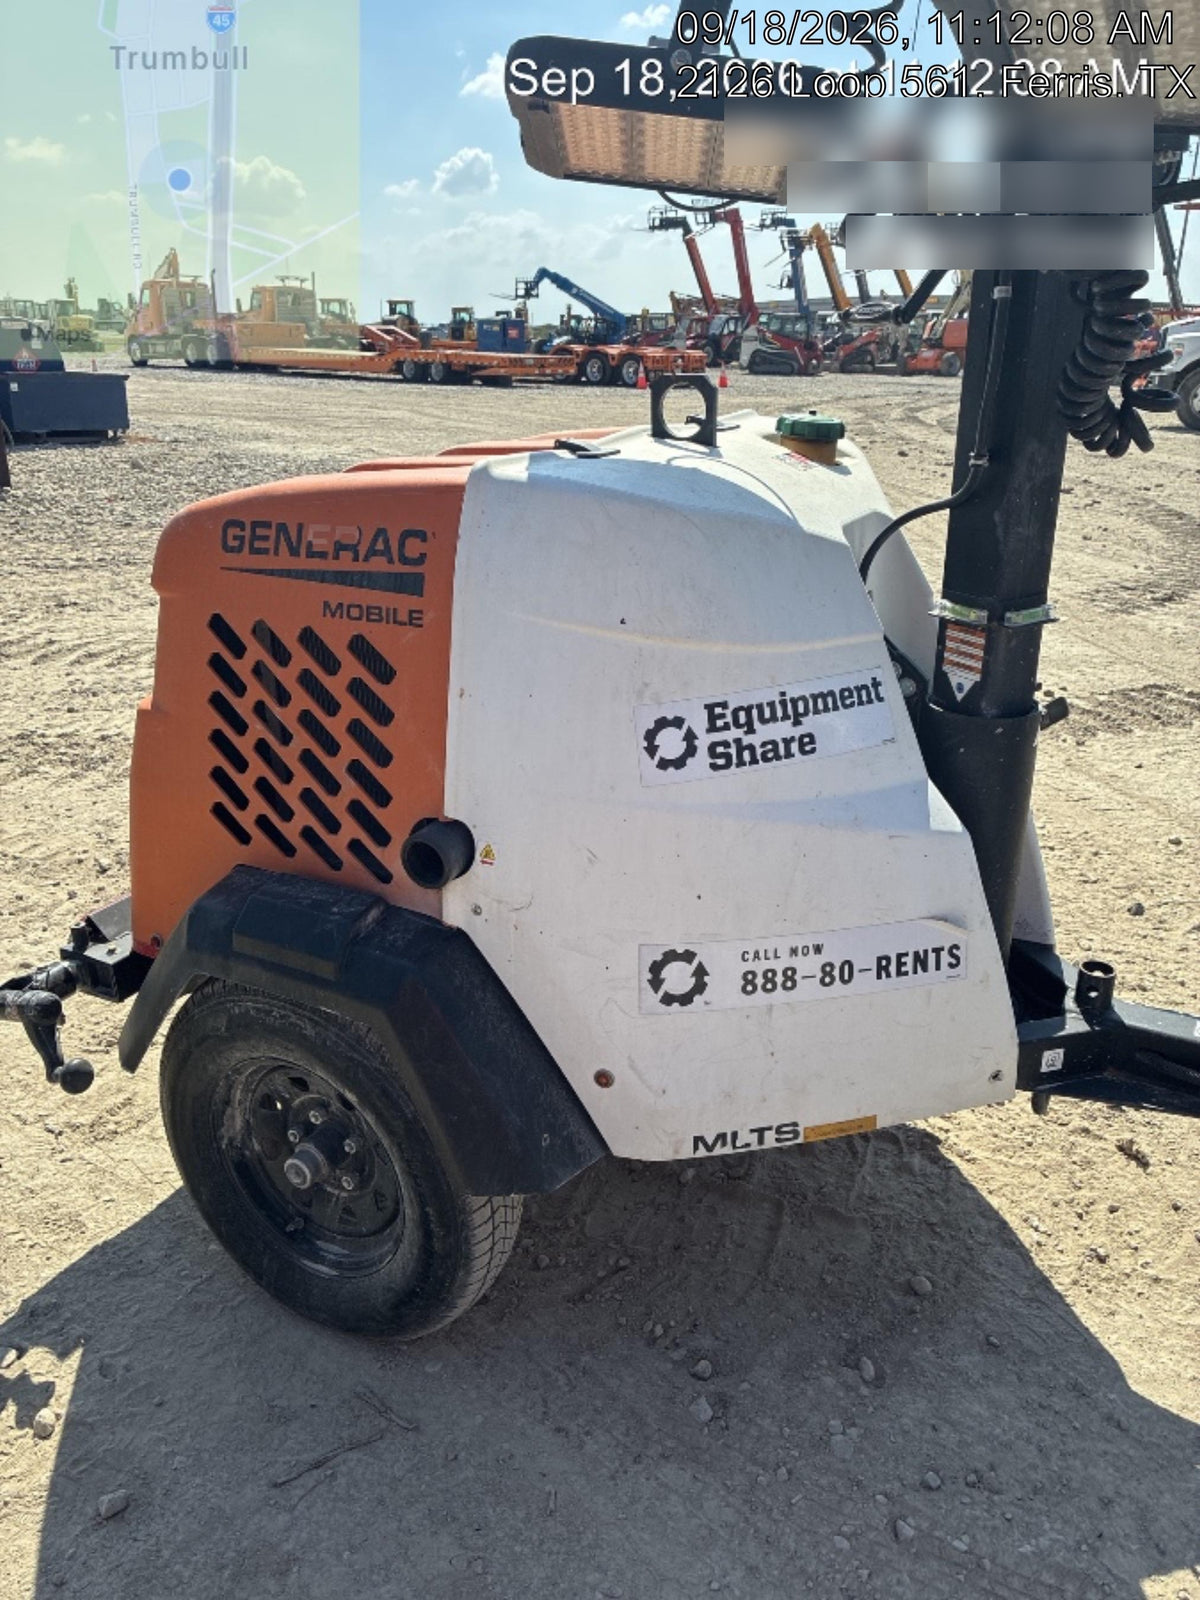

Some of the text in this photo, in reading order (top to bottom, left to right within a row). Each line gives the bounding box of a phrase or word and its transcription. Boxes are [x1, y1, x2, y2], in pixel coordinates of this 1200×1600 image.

[221, 518, 428, 567] GENERAC
[322, 600, 424, 628] MOBILE
[704, 677, 885, 735] Equipment
[707, 731, 817, 771] Share
[741, 943, 825, 963] CALL NOW
[741, 944, 961, 996] 888-80-RENTS
[693, 1121, 800, 1155] MLTS
